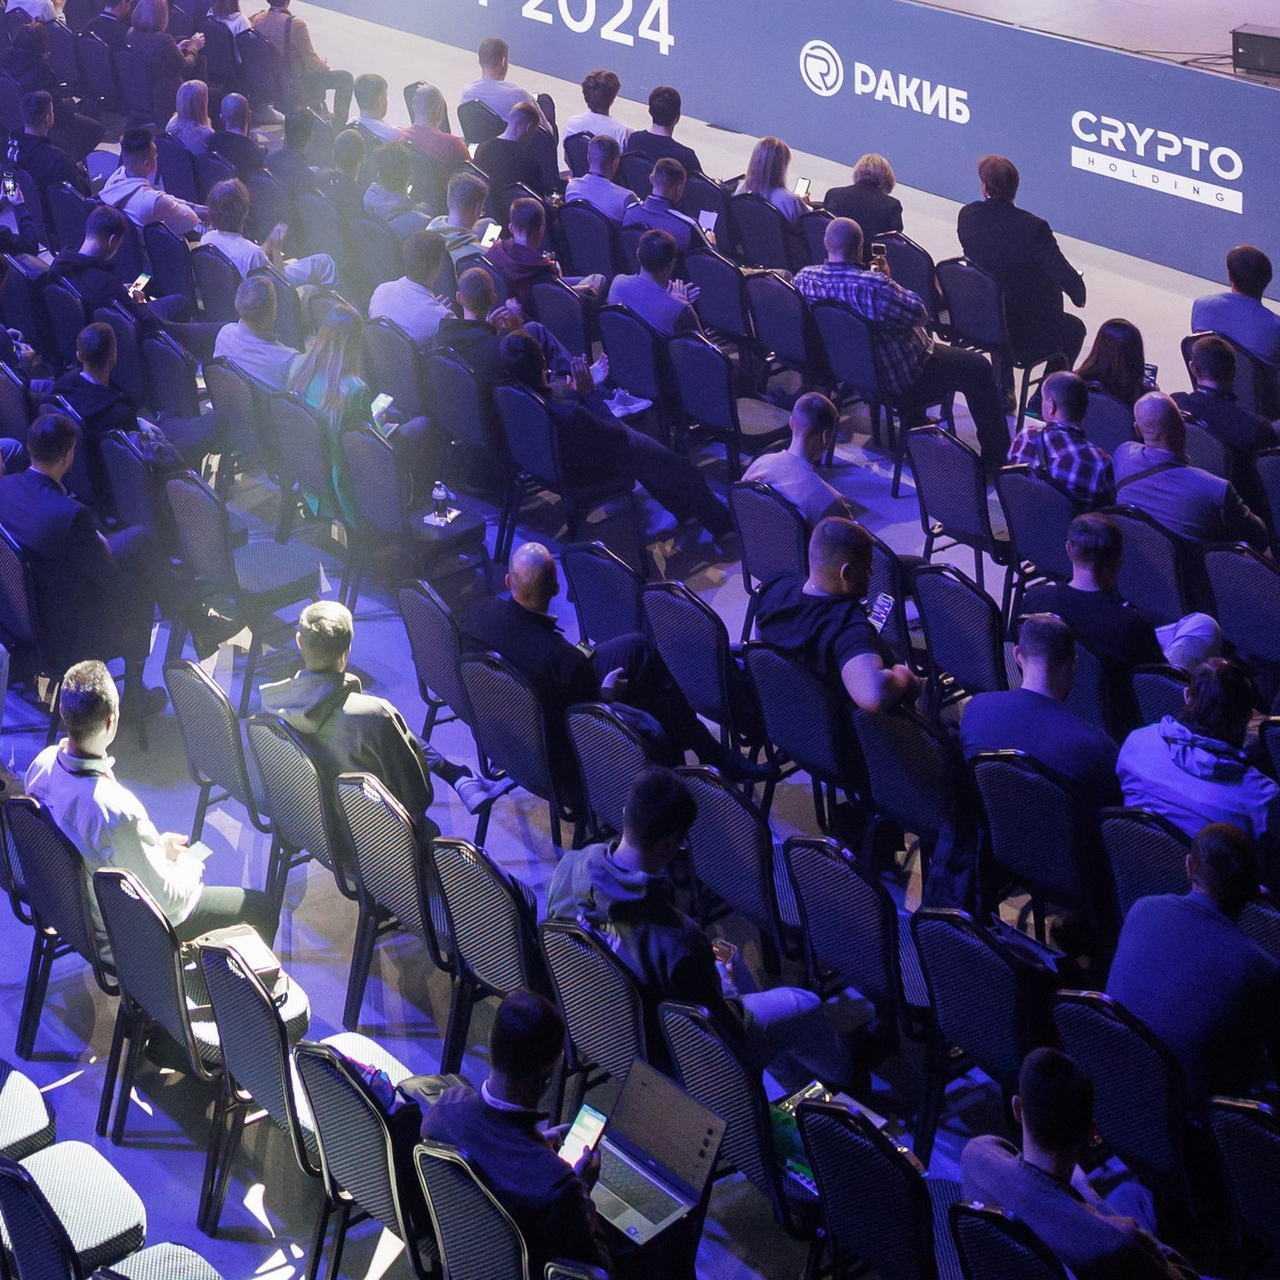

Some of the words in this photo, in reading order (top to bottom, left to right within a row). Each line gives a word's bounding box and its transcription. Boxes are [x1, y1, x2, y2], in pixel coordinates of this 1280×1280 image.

[853, 61, 971, 125] РАКИБ
[1070, 110, 1244, 181] CRYPTO
[1087, 156, 1225, 202] HOLDING
